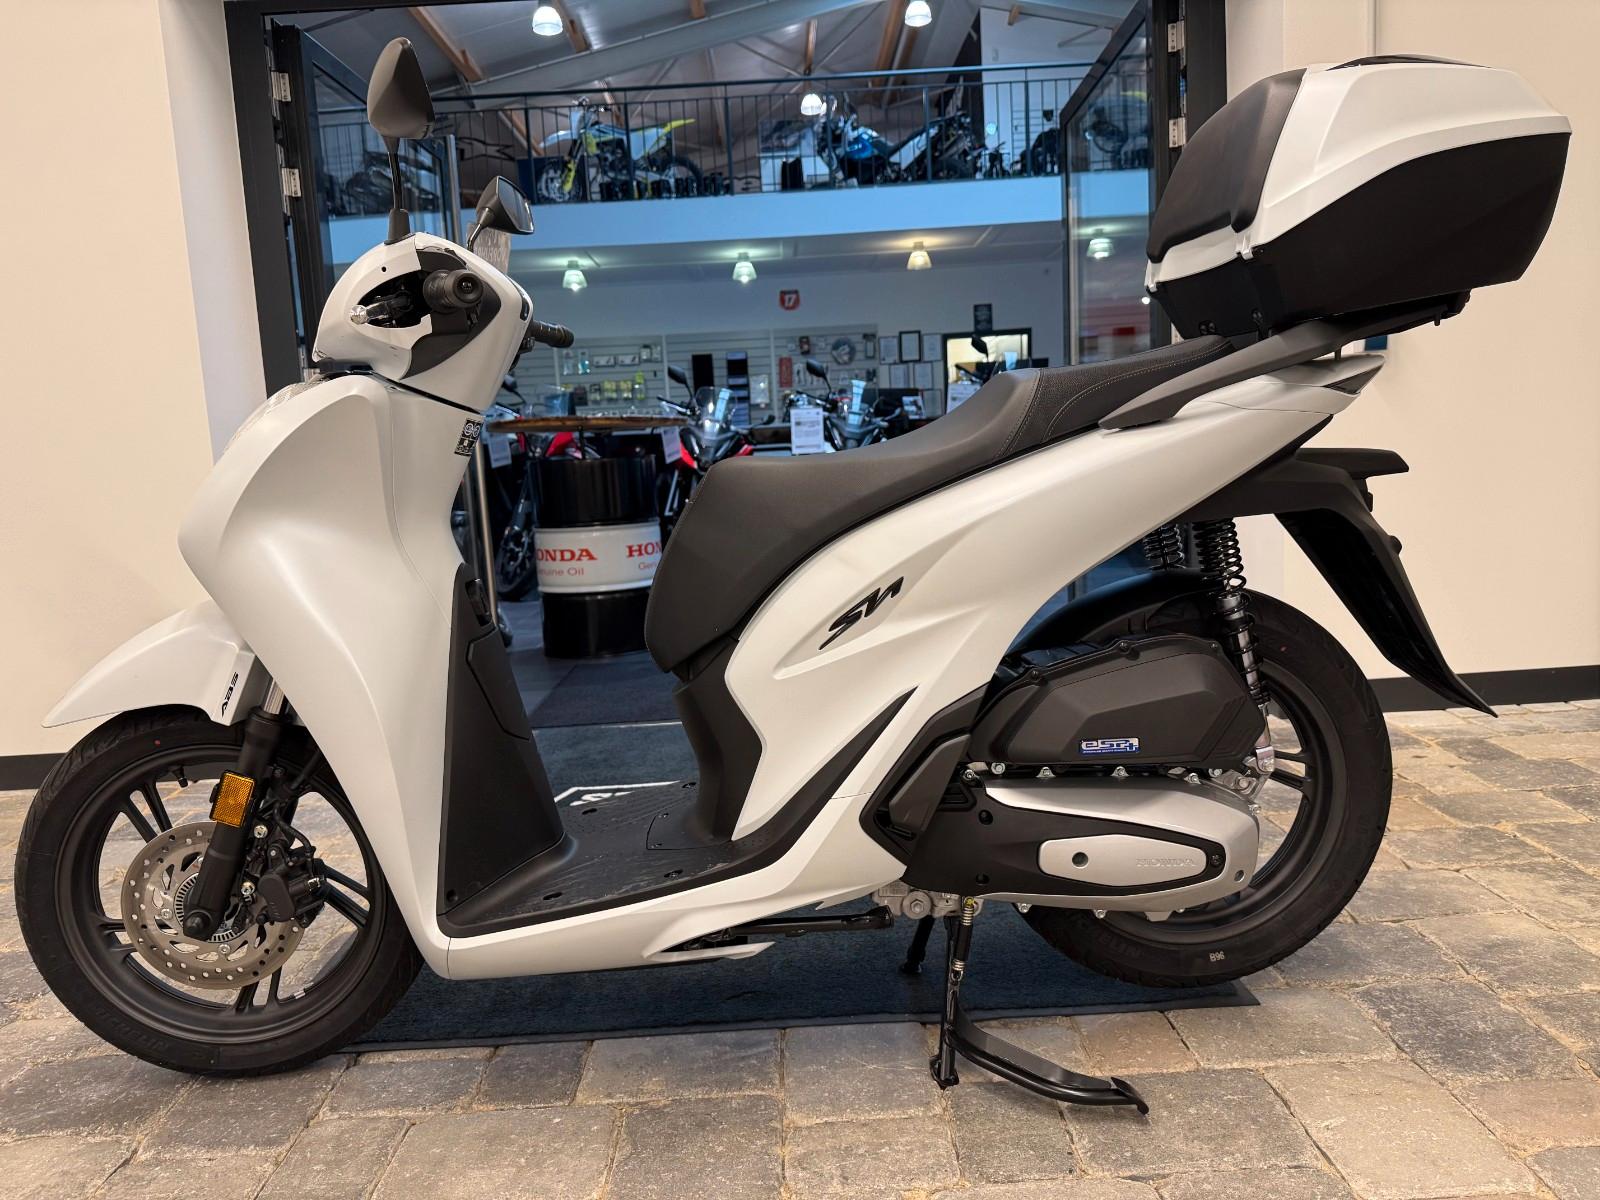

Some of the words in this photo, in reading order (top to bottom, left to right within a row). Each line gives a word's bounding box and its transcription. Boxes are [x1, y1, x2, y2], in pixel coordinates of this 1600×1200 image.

[536, 548, 598, 562] ONDA
[567, 567, 585, 577] Oil
[222, 671, 239, 718] ABS
[1136, 858, 1196, 868] HONDA
[1209, 950, 1225, 963] B96
